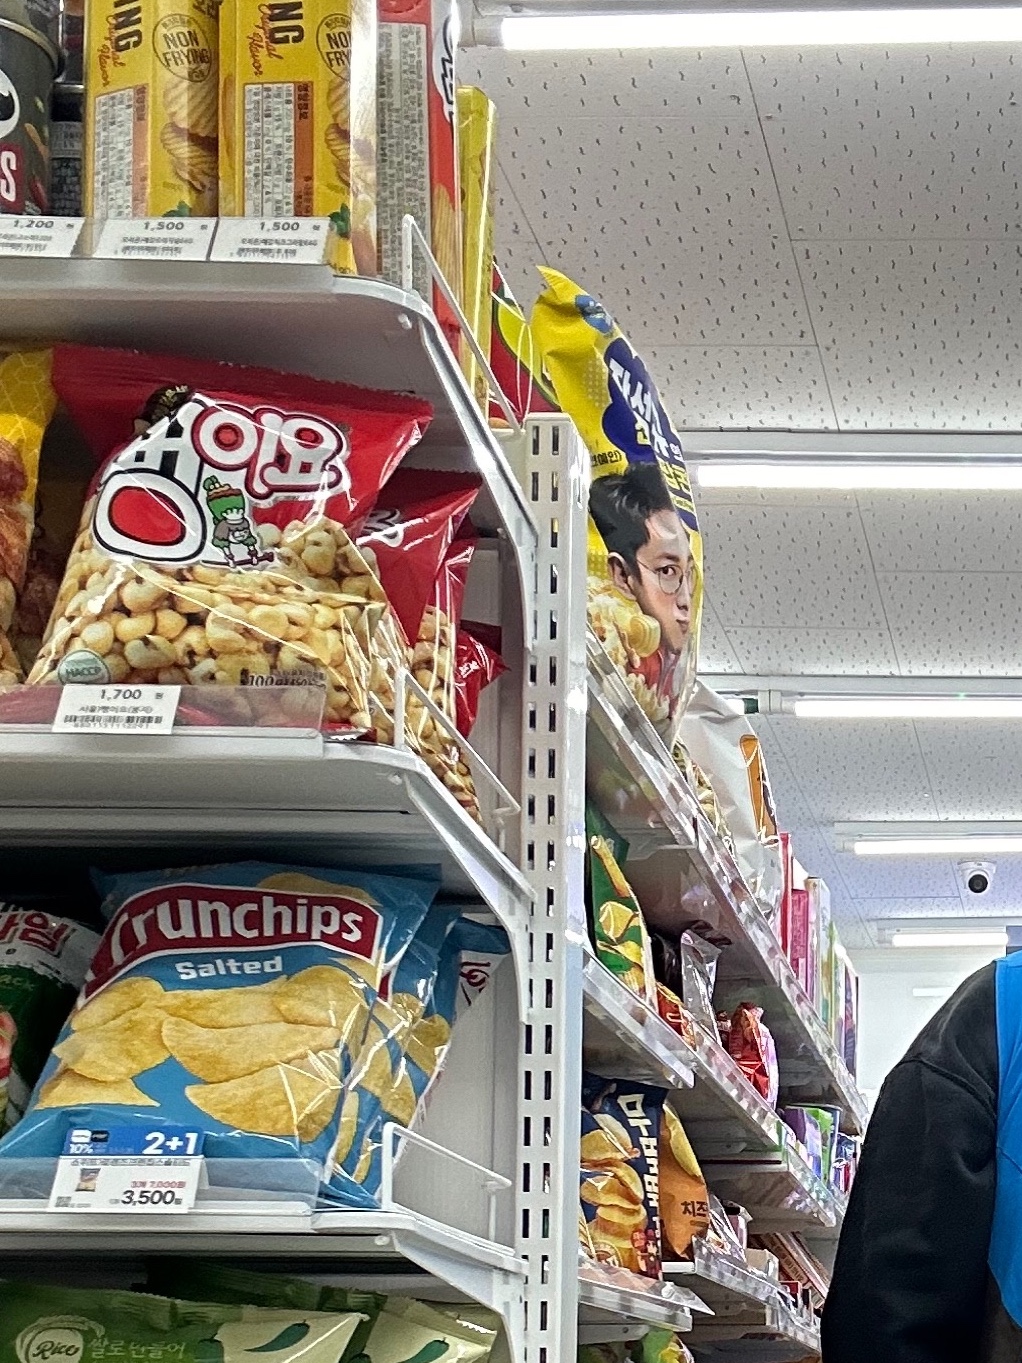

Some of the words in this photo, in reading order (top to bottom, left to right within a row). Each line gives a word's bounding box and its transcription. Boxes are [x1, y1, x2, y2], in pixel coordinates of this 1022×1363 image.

[162, 29, 199, 50] NON
[162, 47, 209, 68] FRYING
[100, 689, 142, 702] 1,700
[175, 955, 284, 981] Salted
[141, 1131, 199, 1155] 2+1
